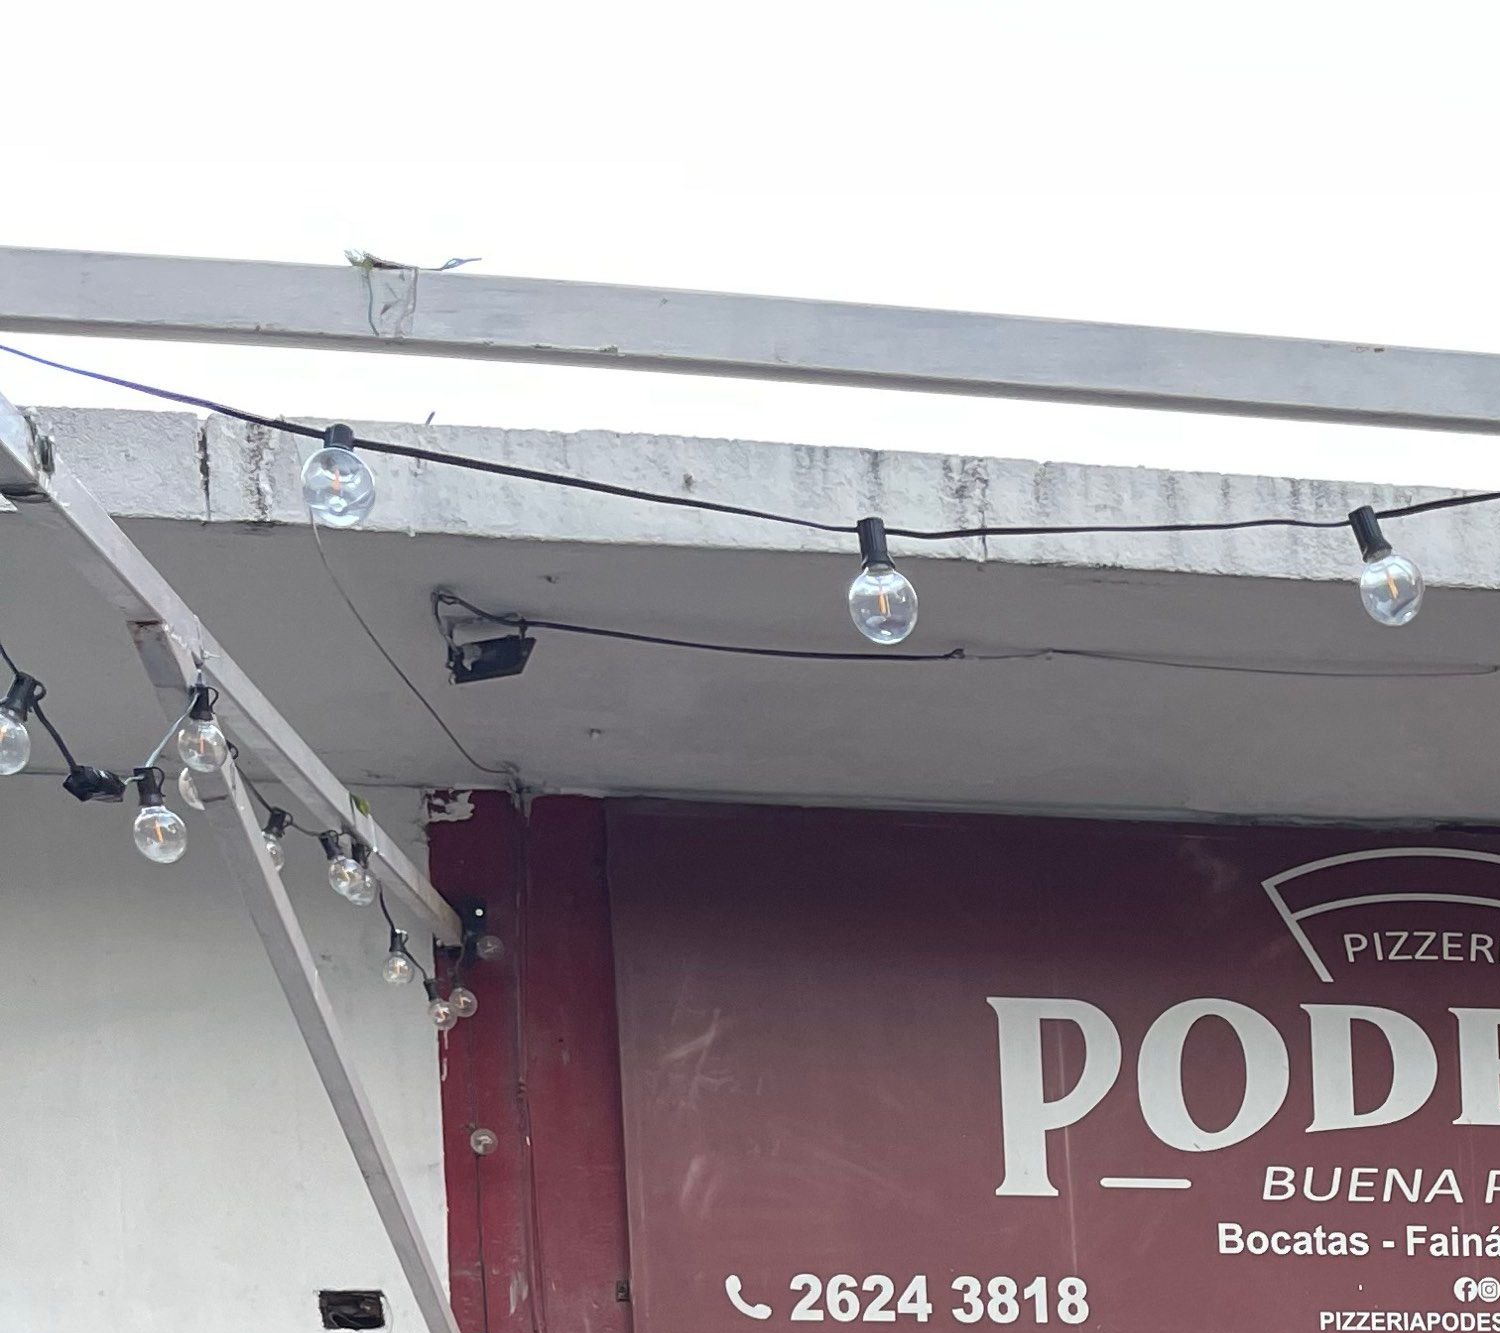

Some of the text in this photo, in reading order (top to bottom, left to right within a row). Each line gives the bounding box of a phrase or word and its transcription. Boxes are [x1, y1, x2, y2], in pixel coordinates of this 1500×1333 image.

[1262, 1166, 1464, 1204] BUENA
[1217, 1222, 1370, 1256] Bocatas
[789, 1273, 1089, 1324] 2624 3818
